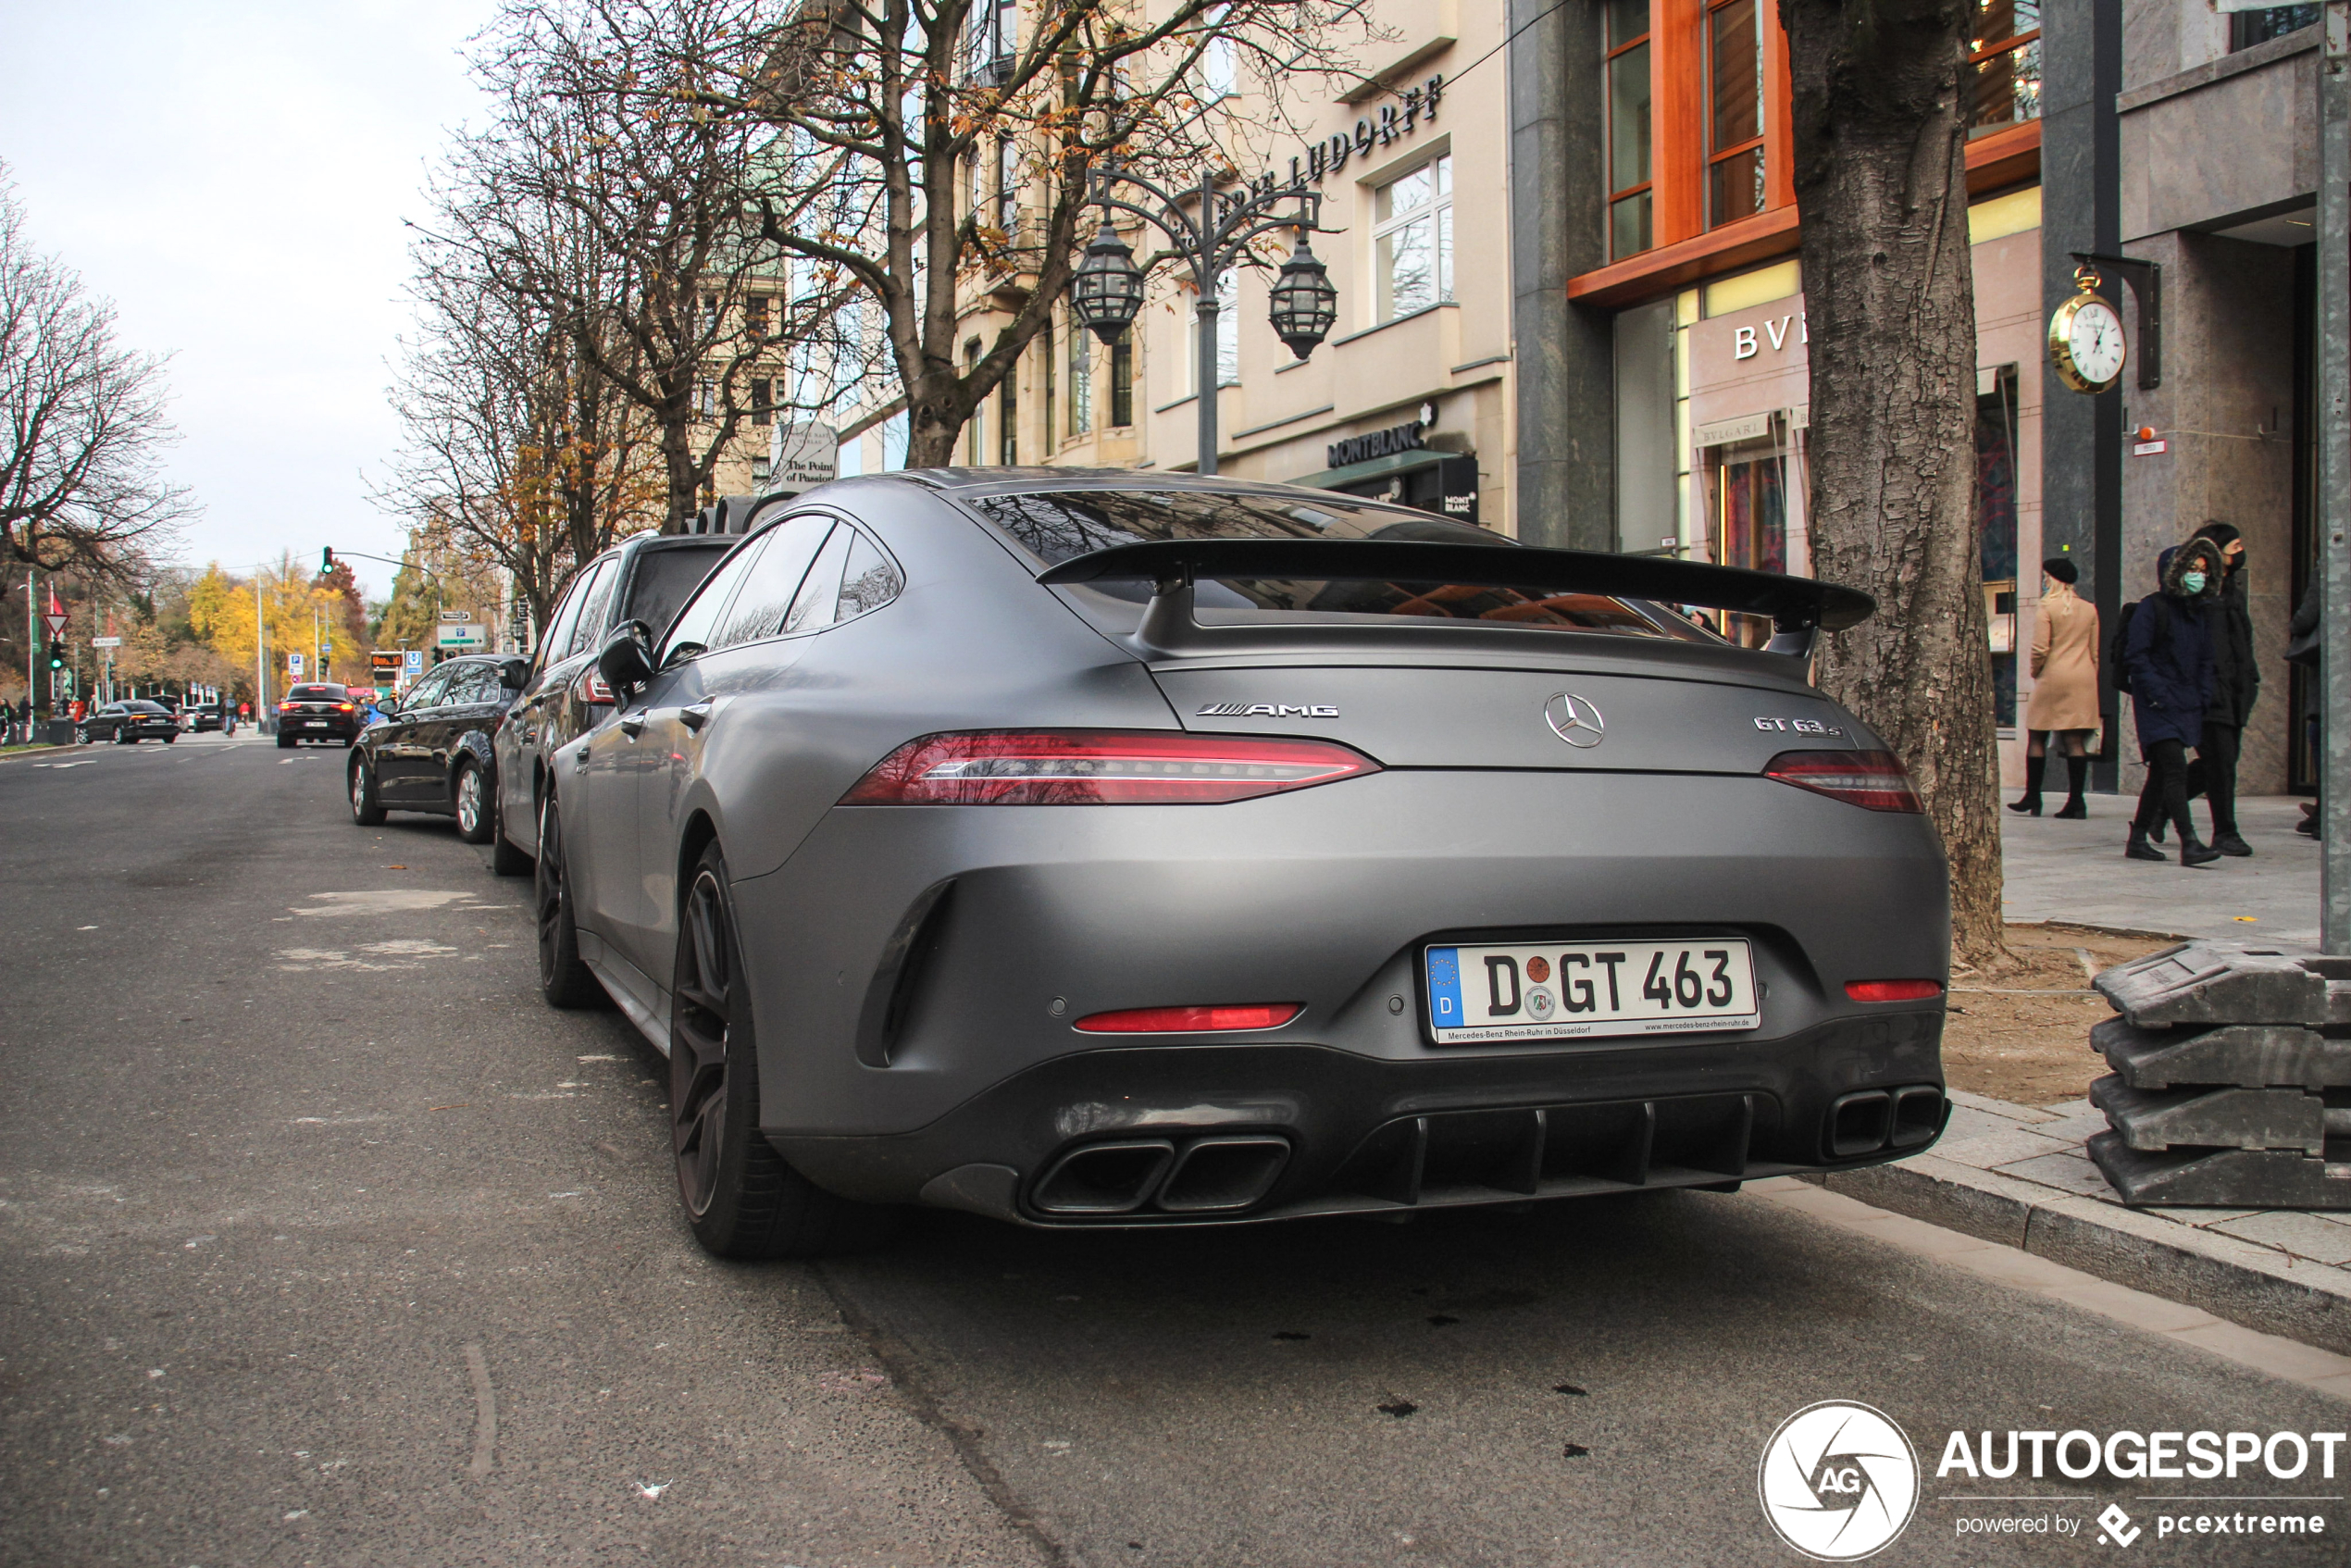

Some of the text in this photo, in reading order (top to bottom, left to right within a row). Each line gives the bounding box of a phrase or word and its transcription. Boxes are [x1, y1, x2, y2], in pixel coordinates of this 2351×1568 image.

[1288, 74, 1441, 189] LUDORFF
[1703, 423, 1757, 442] BVLGARI
[1328, 420, 1422, 467] MONTBLANC
[790, 461, 833, 471] The Point
[787, 473, 797, 482] of
[1445, 495, 1470, 504] MONT
[1445, 504, 1470, 513] BLANC
[1243, 703, 1339, 718] AMG
[1754, 716, 1786, 731] GT
[1792, 719, 1824, 733] 63
[1484, 955, 1522, 1016] D
[1560, 952, 1626, 1013] GT
[1643, 950, 1733, 1010] 463
[1439, 997, 1452, 1014] D
[1448, 1026, 1591, 1039] Mercedes-Benz Rhein-Ruhr in Düsseldorf
[1645, 1019, 1749, 1031] www.mercedes-benz-rhein-ruhr.de
